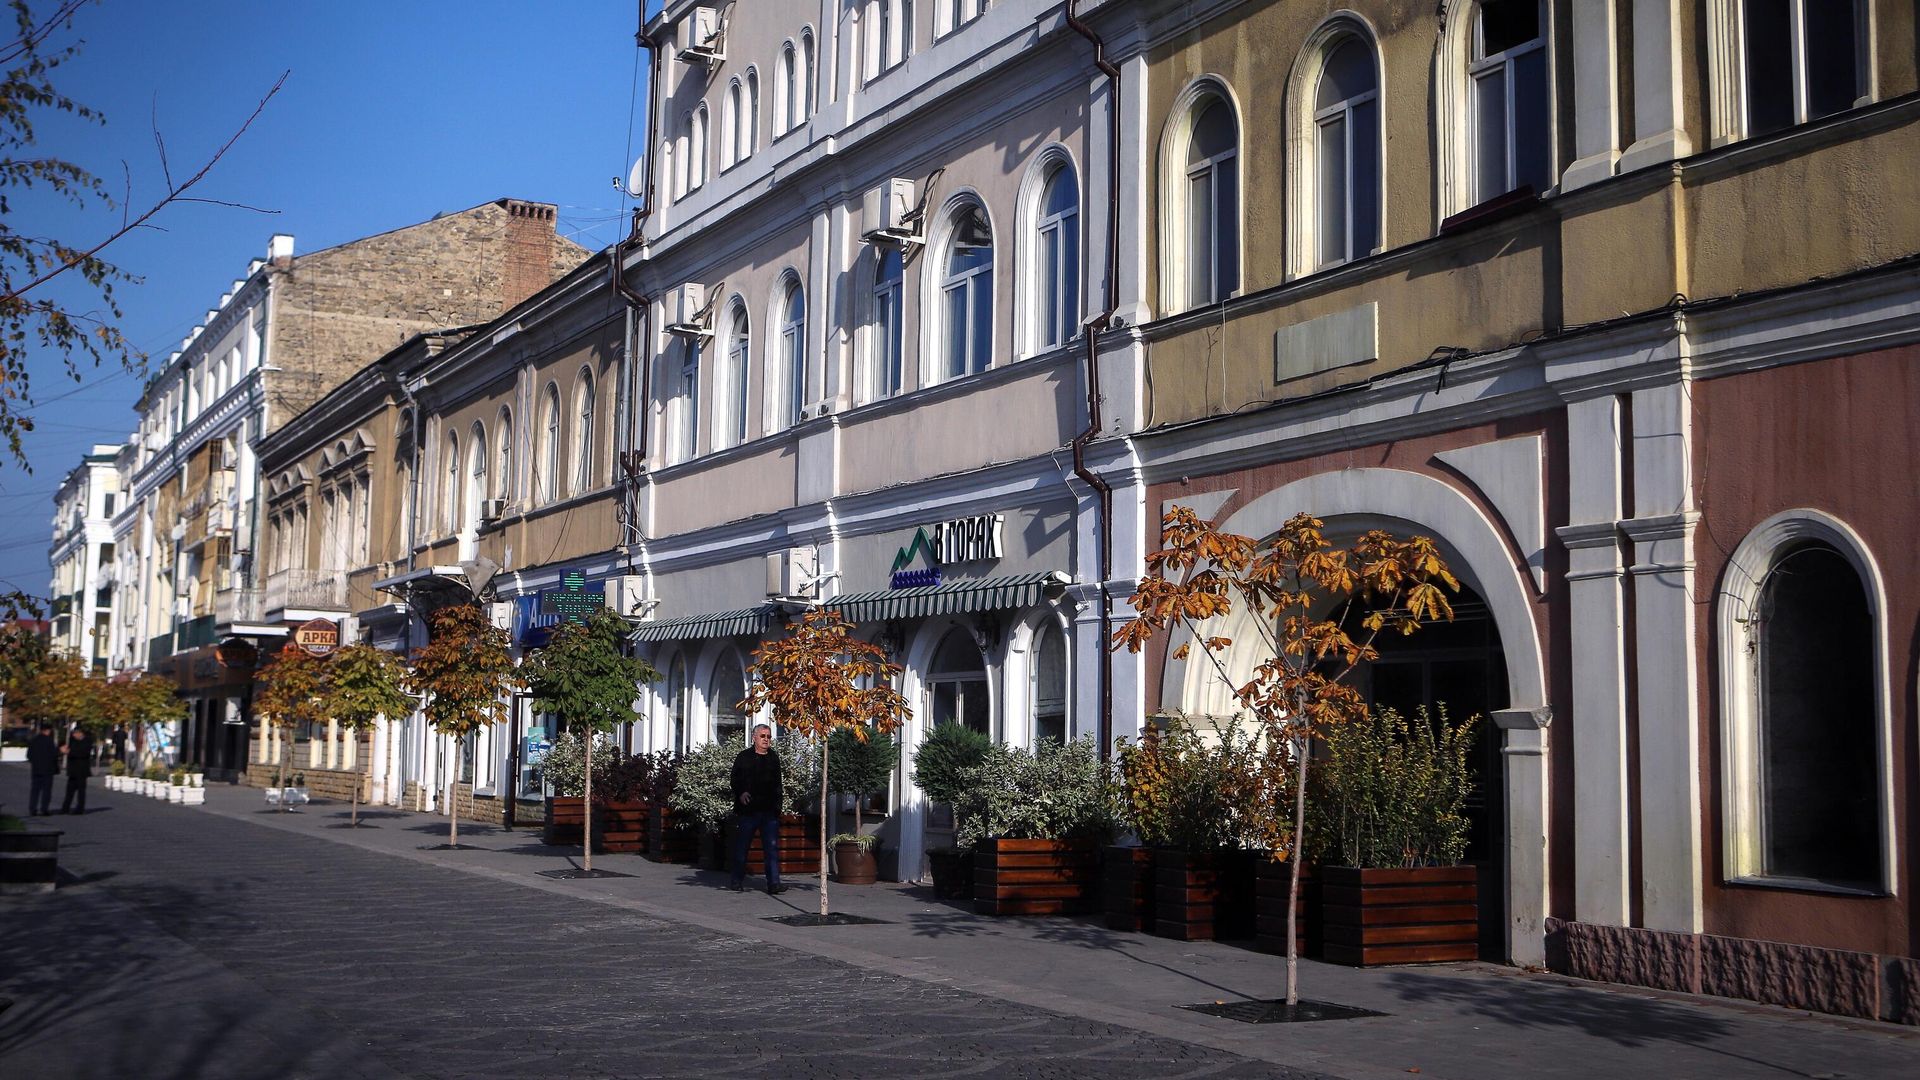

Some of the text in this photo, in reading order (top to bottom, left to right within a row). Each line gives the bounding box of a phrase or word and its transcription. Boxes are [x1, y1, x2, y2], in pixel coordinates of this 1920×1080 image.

[935, 513, 1004, 564] В ГОРАХ
[302, 631, 337, 644] АРКА
